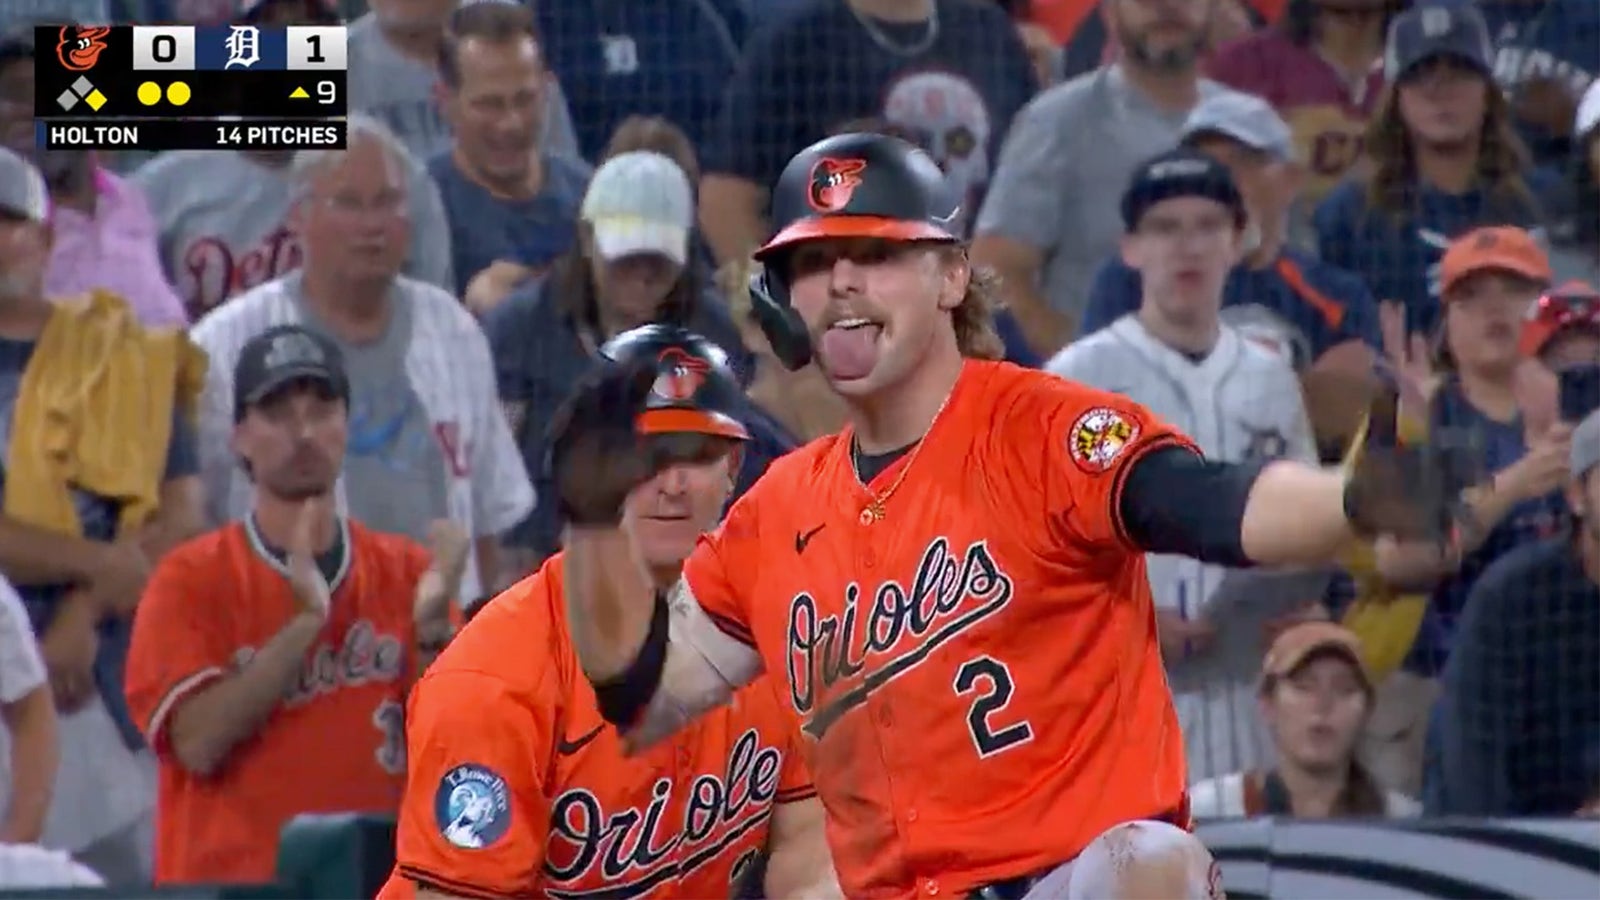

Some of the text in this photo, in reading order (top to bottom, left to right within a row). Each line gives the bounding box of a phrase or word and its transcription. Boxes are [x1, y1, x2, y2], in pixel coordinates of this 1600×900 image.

[786, 535, 1015, 742] Orioles
[953, 654, 1035, 760] 2
[544, 728, 783, 882] Oriole
